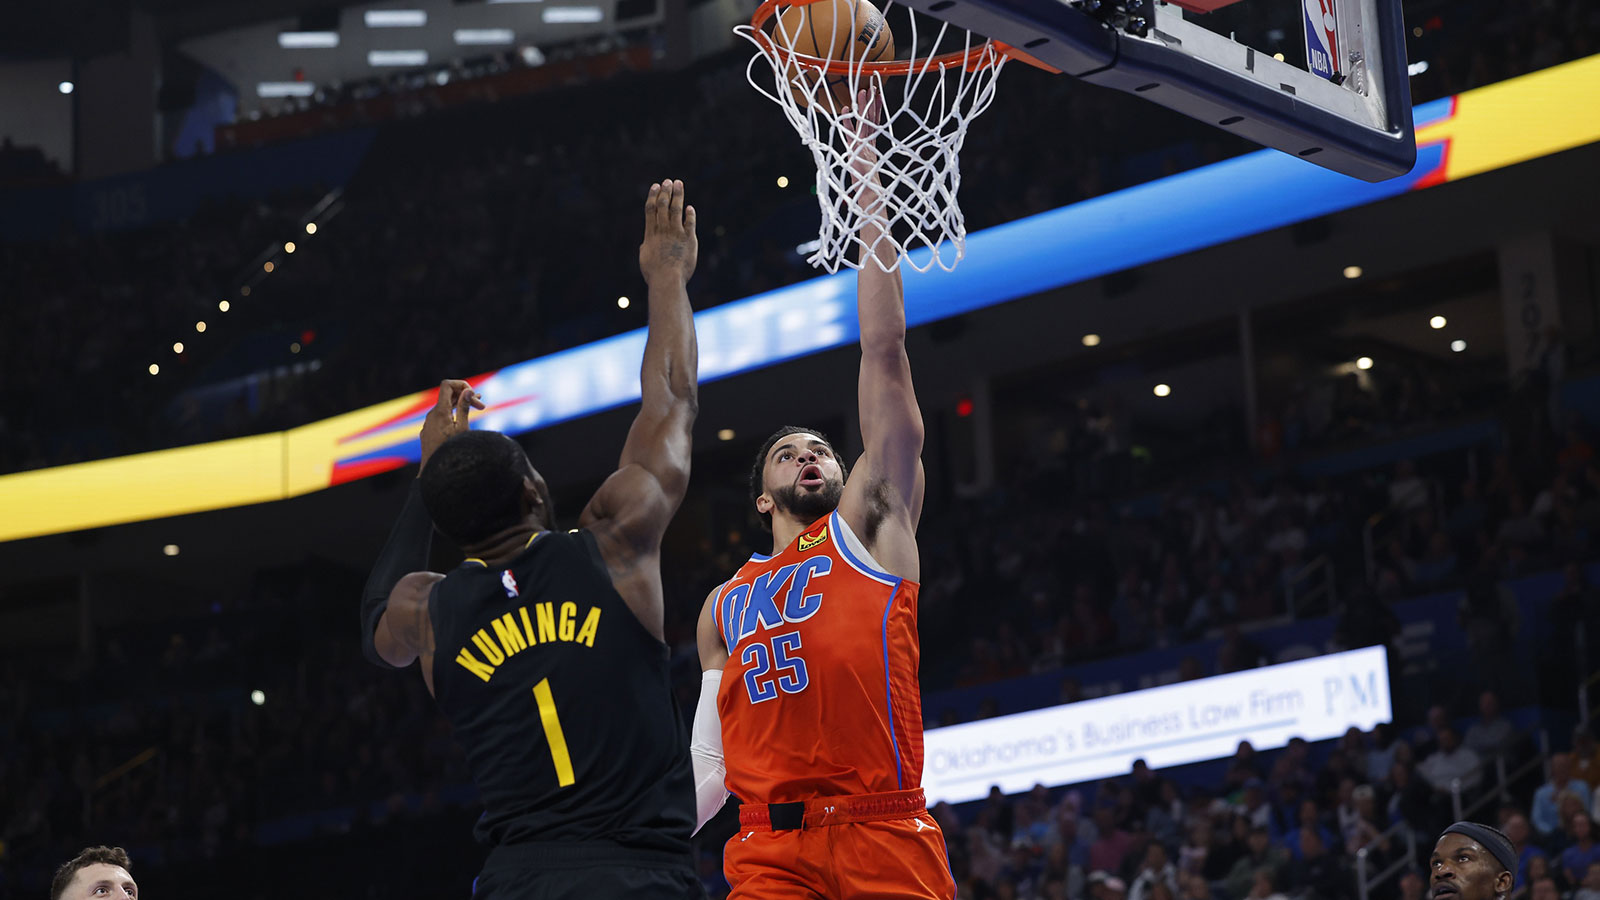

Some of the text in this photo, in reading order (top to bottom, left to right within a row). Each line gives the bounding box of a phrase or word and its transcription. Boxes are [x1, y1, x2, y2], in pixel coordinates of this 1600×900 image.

[1311, 48, 1328, 73] NBA
[455, 601, 602, 683] KUMINGA
[721, 554, 832, 656] OKC
[741, 630, 809, 705] 25
[532, 677, 576, 788] 1
[929, 688, 1305, 776] Oklahoma's Business Law Firm
